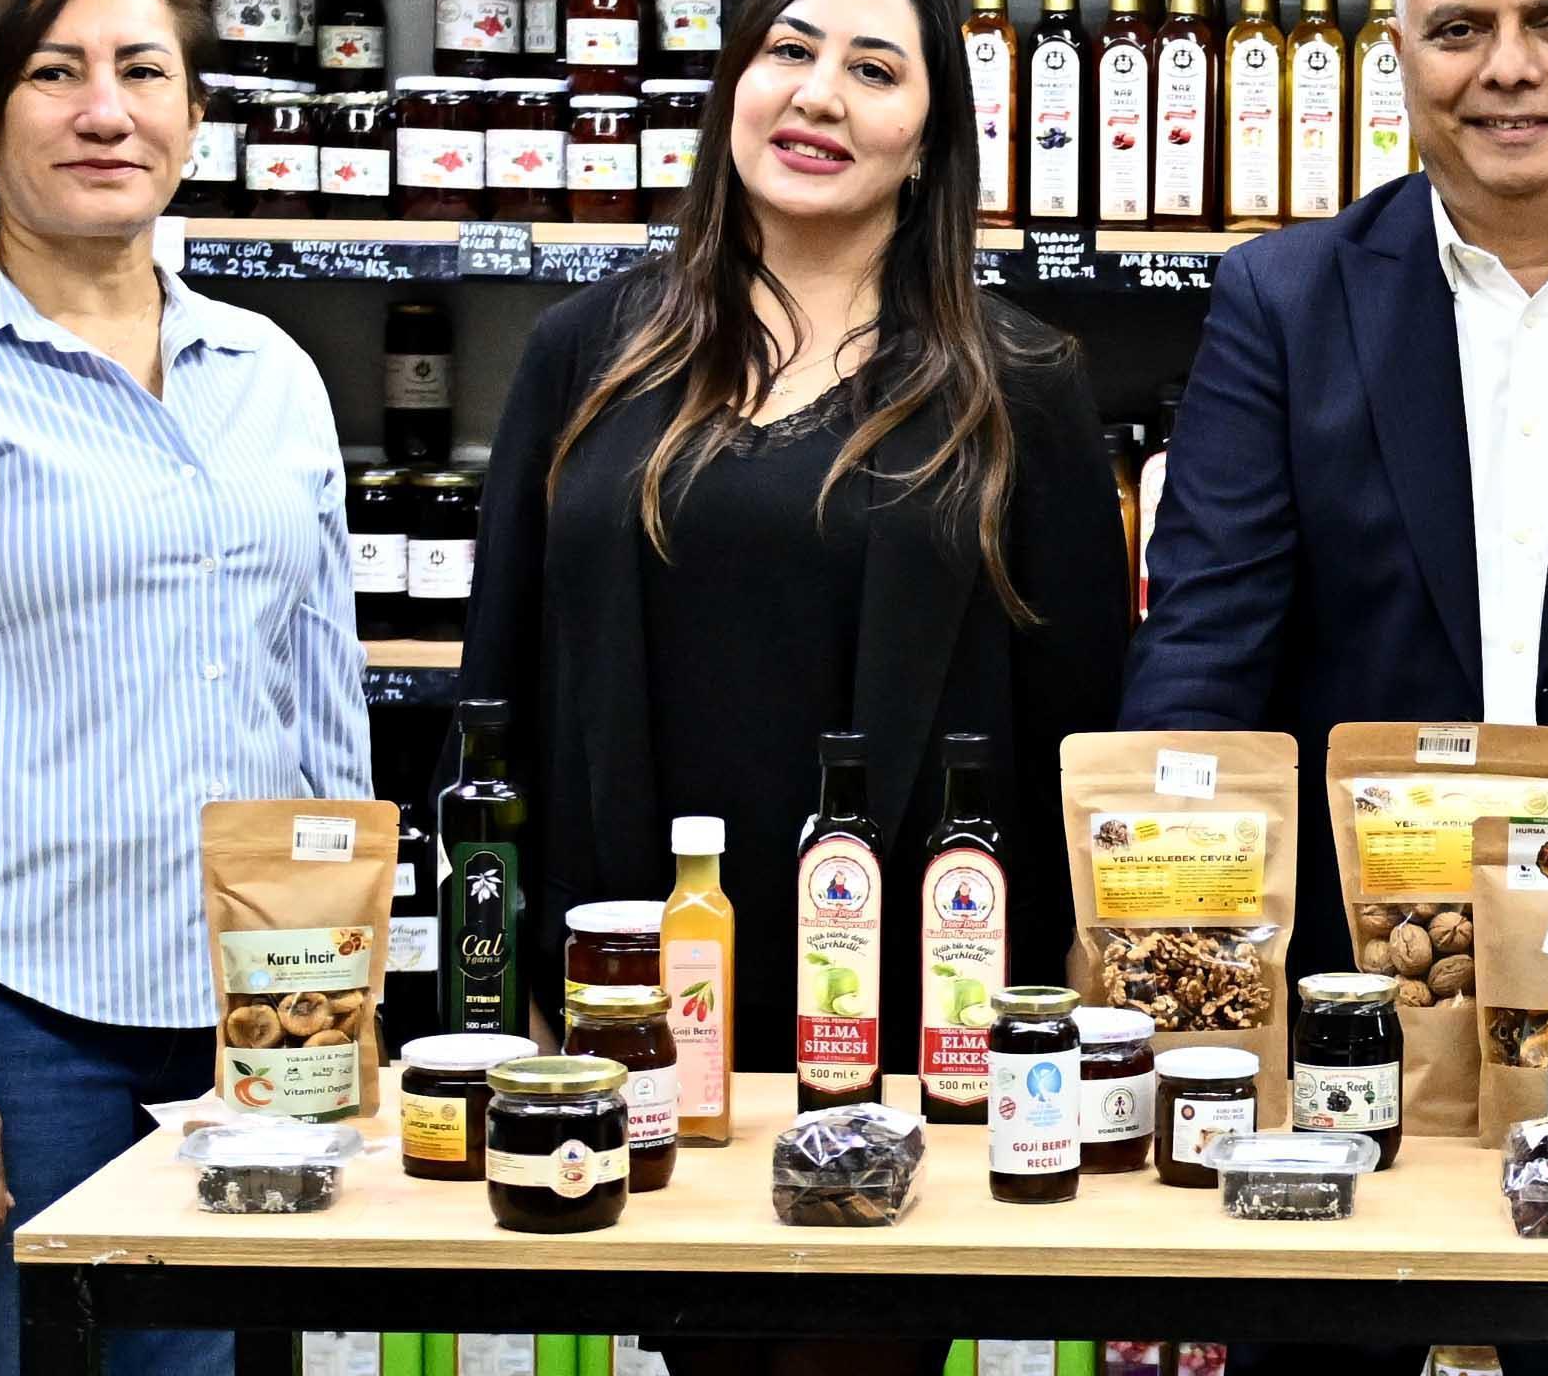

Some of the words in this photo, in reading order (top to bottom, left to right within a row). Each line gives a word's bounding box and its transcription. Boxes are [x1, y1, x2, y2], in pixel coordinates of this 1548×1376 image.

[190, 242, 232, 256] HATAY
[1119, 253, 1152, 268] NAR
[461, 932, 504, 957] Cal
[266, 950, 300, 966] Kuru
[303, 947, 336, 965] İncir
[813, 1025, 860, 1039] ELMA
[804, 1039, 869, 1055] SİRKESİ
[941, 1036, 987, 1049] ELMA
[932, 1050, 988, 1066] SİRKES
[809, 1067, 831, 1079] 500
[833, 1067, 848, 1079] ml
[938, 1079, 960, 1091] 500
[962, 1079, 976, 1091] ml
[1042, 1138, 1072, 1151] BERRY
